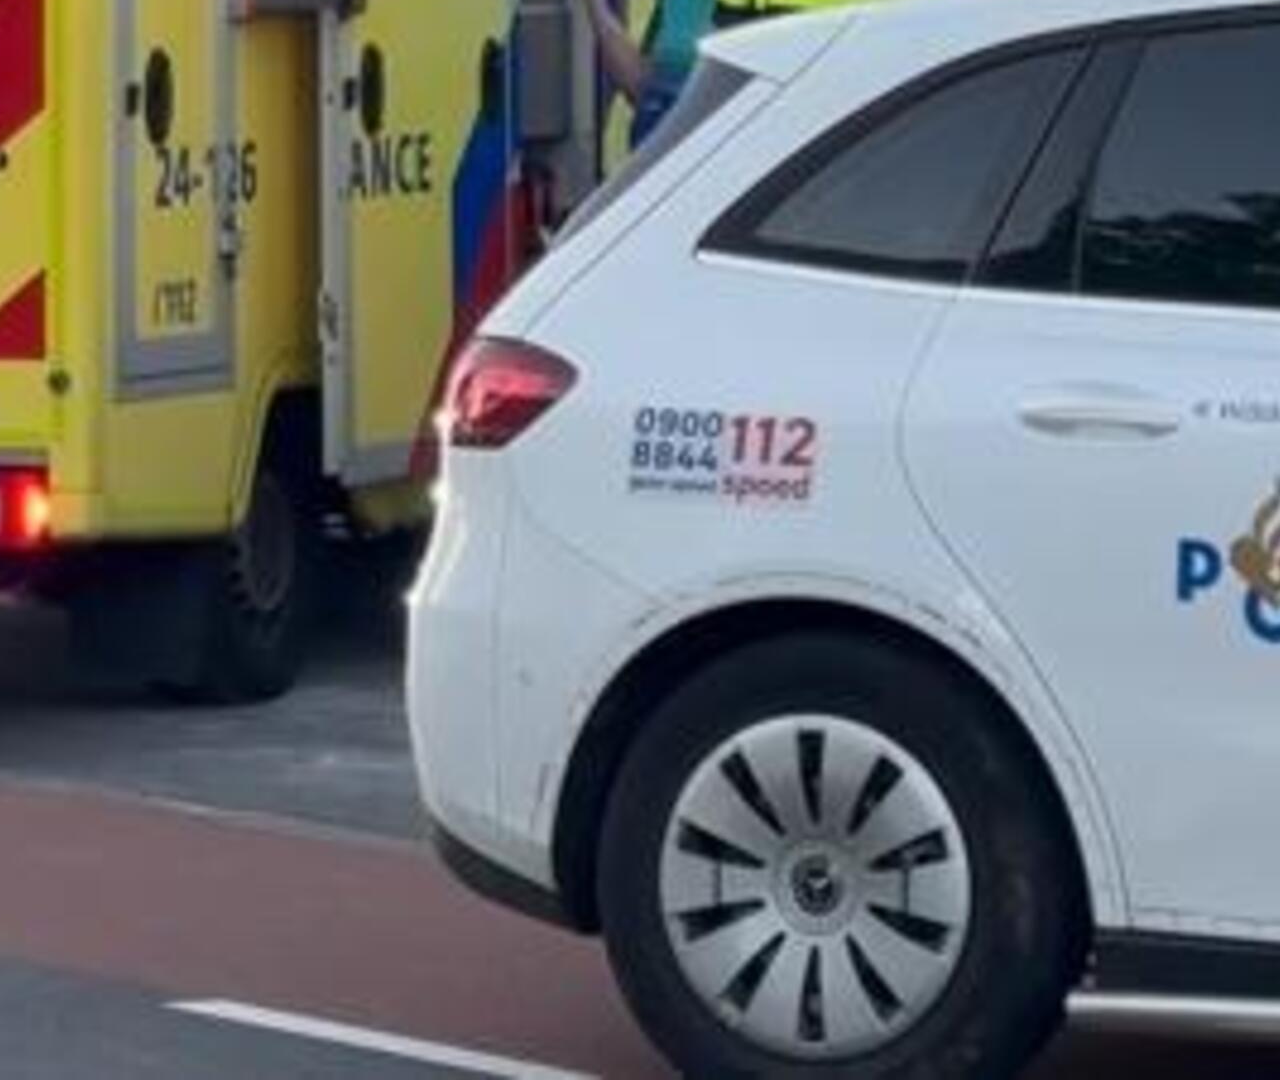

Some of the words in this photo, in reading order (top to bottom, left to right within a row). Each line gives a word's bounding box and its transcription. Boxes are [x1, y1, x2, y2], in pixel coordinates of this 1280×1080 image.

[340, 132, 433, 202] ANCE
[634, 408, 722, 438] 0900
[732, 417, 816, 466] 112
[632, 441, 718, 471] 8844
